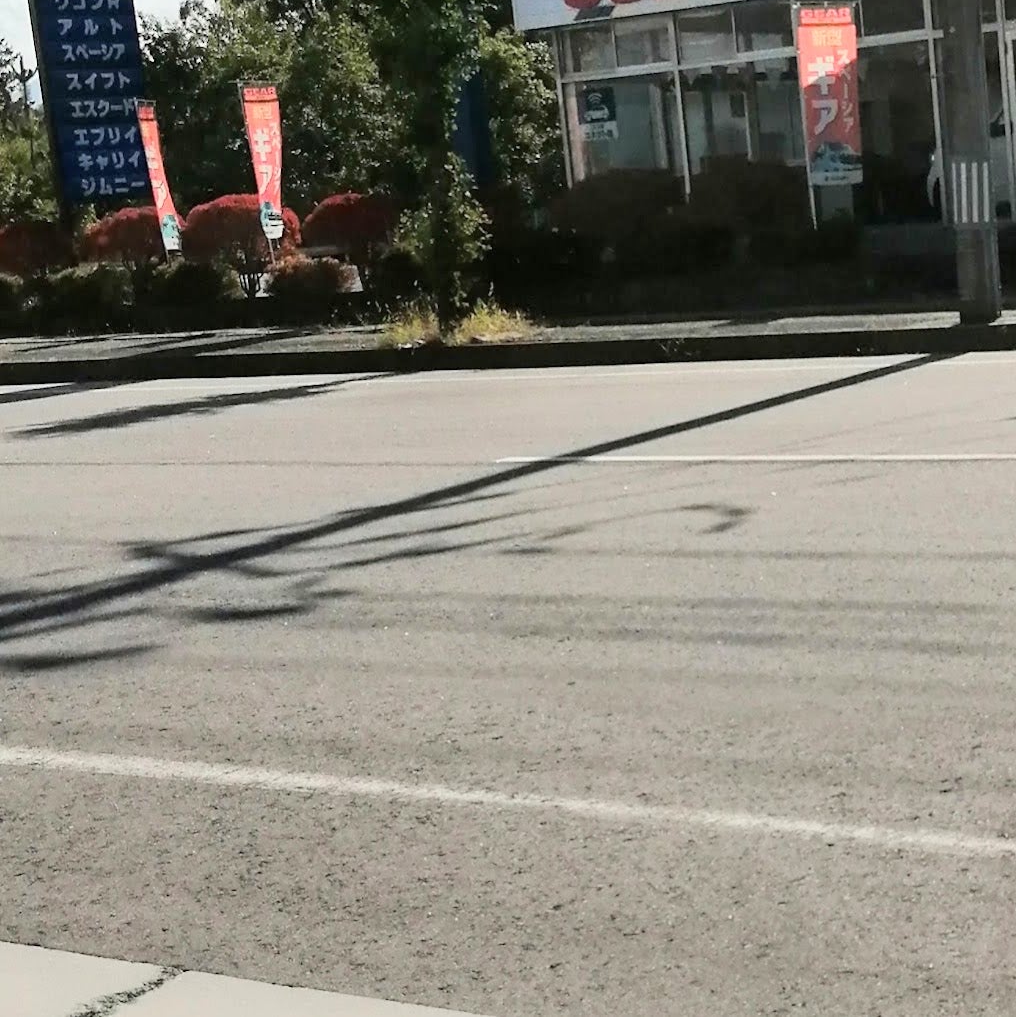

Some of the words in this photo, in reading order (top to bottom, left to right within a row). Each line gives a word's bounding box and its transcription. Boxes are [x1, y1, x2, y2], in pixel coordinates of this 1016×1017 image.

[57, 18, 123, 36] アルト
[61, 44, 126, 62] スペーシア
[66, 73, 131, 91] スイフト
[70, 99, 135, 119] エスクード
[78, 150, 141, 171] キャリイ
[81, 178, 146, 196] ジムニー
